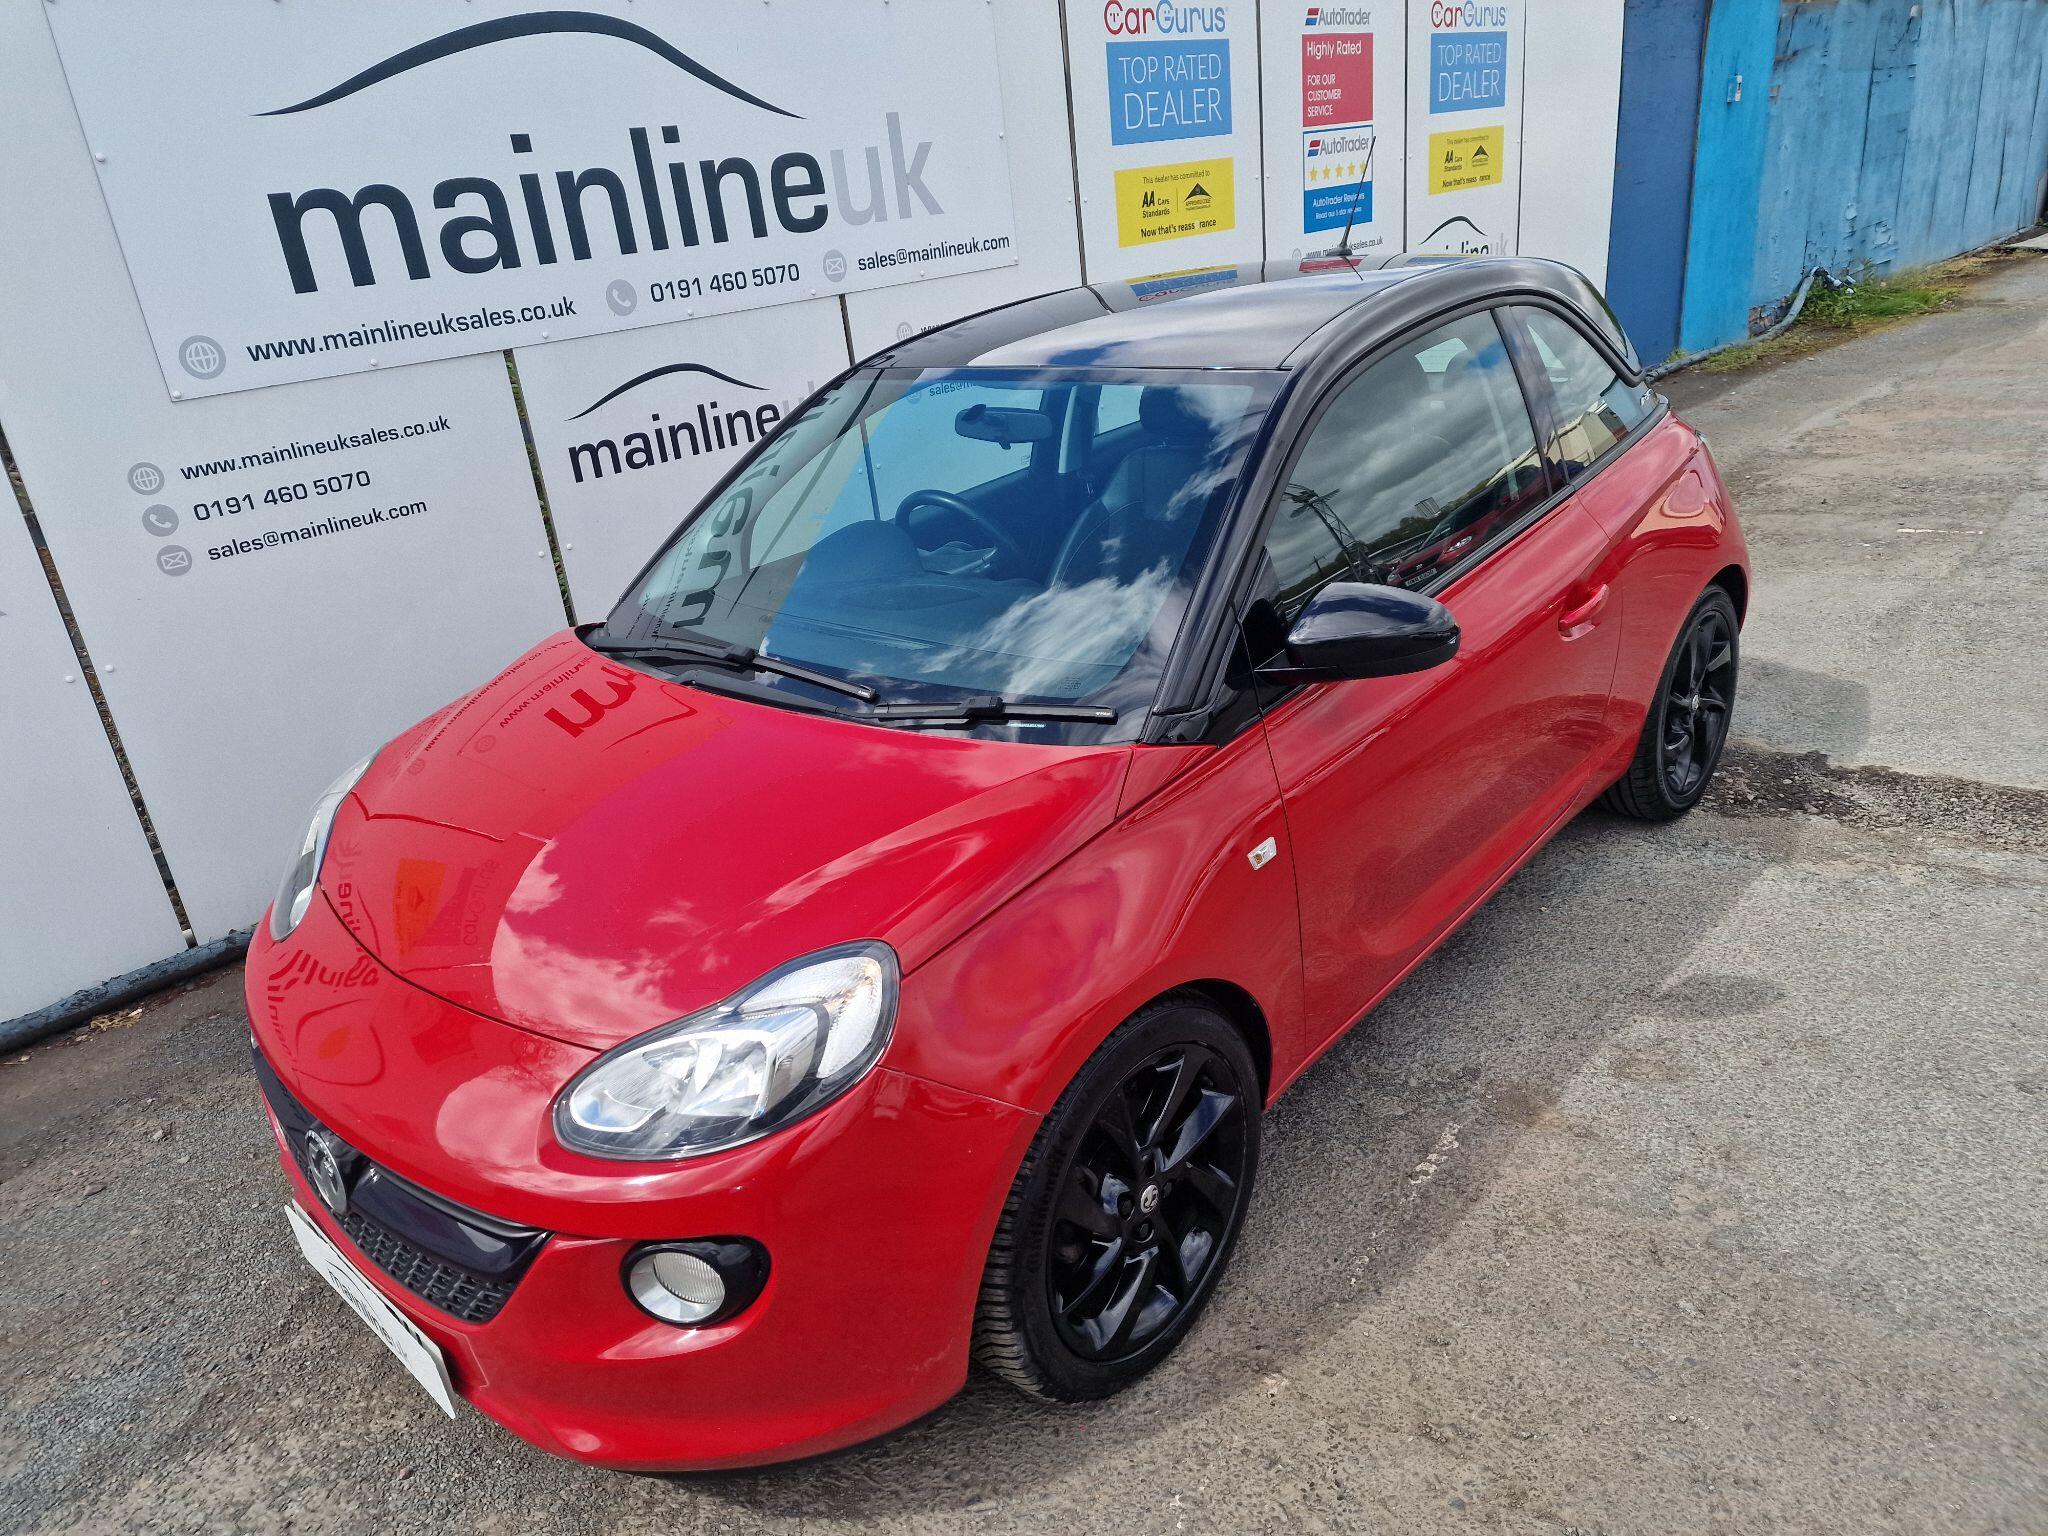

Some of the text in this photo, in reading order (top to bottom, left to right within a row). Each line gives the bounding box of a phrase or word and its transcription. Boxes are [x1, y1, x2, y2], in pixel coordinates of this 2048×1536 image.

[1104, 0, 1226, 35] CarGurus
[1318, 8, 1371, 26] AutoTrader
[1431, 0, 1506, 28] CarGurus
[1307, 40, 1362, 60] Highly Rated
[1438, 43, 1501, 66] TOP RATED
[1118, 54, 1222, 84] TOP RATED
[1308, 74, 1335, 85] FOR OUR
[1308, 89, 1341, 101] CUSTOMER
[1439, 70, 1500, 102] DEALER
[1124, 88, 1222, 130] DEALER
[1308, 105, 1334, 117] SERVICE
[1320, 135, 1369, 156] AutoTrader
[1143, 176, 1154, 184] This
[1142, 190, 1170, 208] AA Cars
[1142, 208, 1170, 219] Standards
[1141, 228, 1156, 238] Now
[858, 233, 1011, 272] sales@mainlineuk.com
[650, 263, 800, 303] 0191 460 5070
[247, 296, 577, 362] www.mainlineuksales.co.uk
[180, 415, 451, 480] www.mainlineuksales.co.uk
[193, 470, 371, 521] 0191 460 5070
[207, 500, 427, 561] sales@mainlineuk.com
